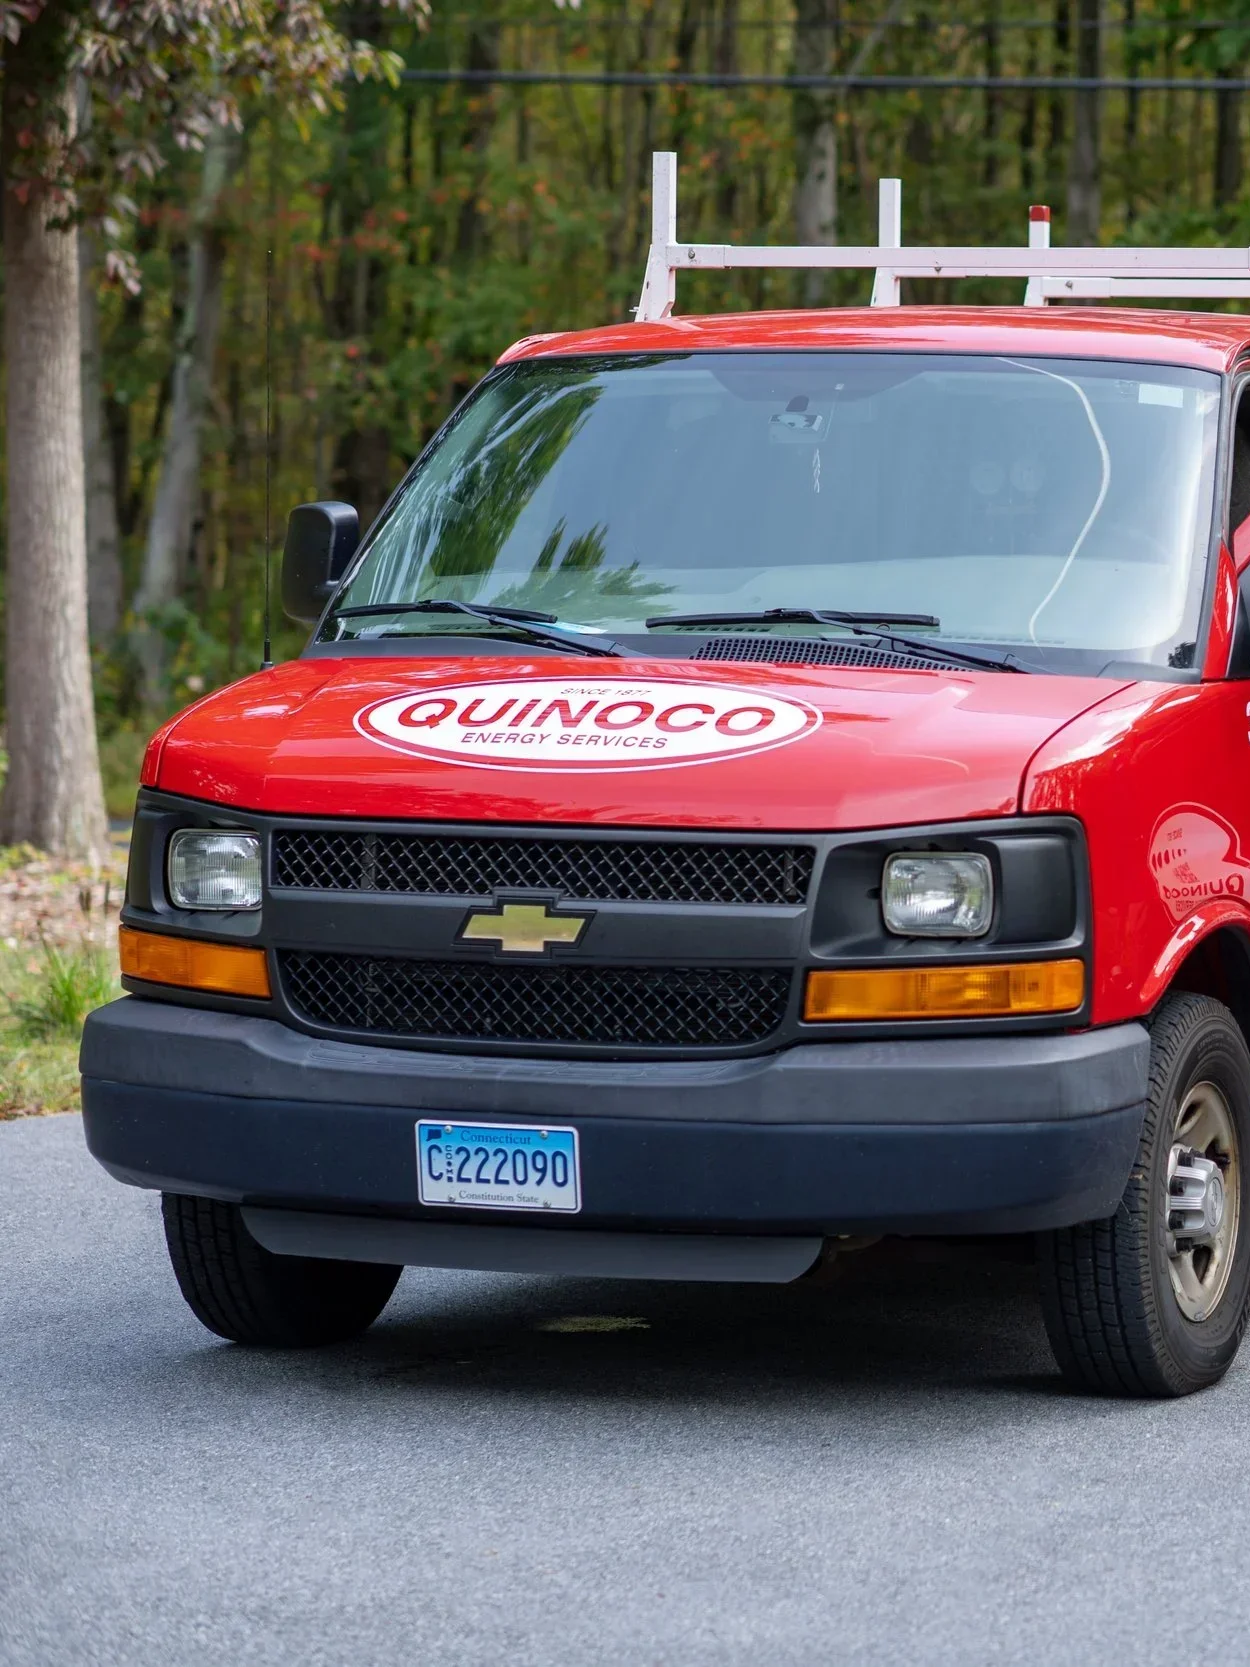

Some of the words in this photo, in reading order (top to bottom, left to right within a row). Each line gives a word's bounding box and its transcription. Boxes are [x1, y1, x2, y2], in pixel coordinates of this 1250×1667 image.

[561, 687, 612, 696] SINCE
[615, 688, 652, 696] 1877
[397, 698, 777, 737] QUINOCO
[460, 732, 551, 745] ENERGY
[556, 733, 669, 749] SERVICES
[460, 1130, 531, 1145] Connecticut
[458, 1190, 514, 1203] Constitution
[516, 1193, 539, 1204] State
